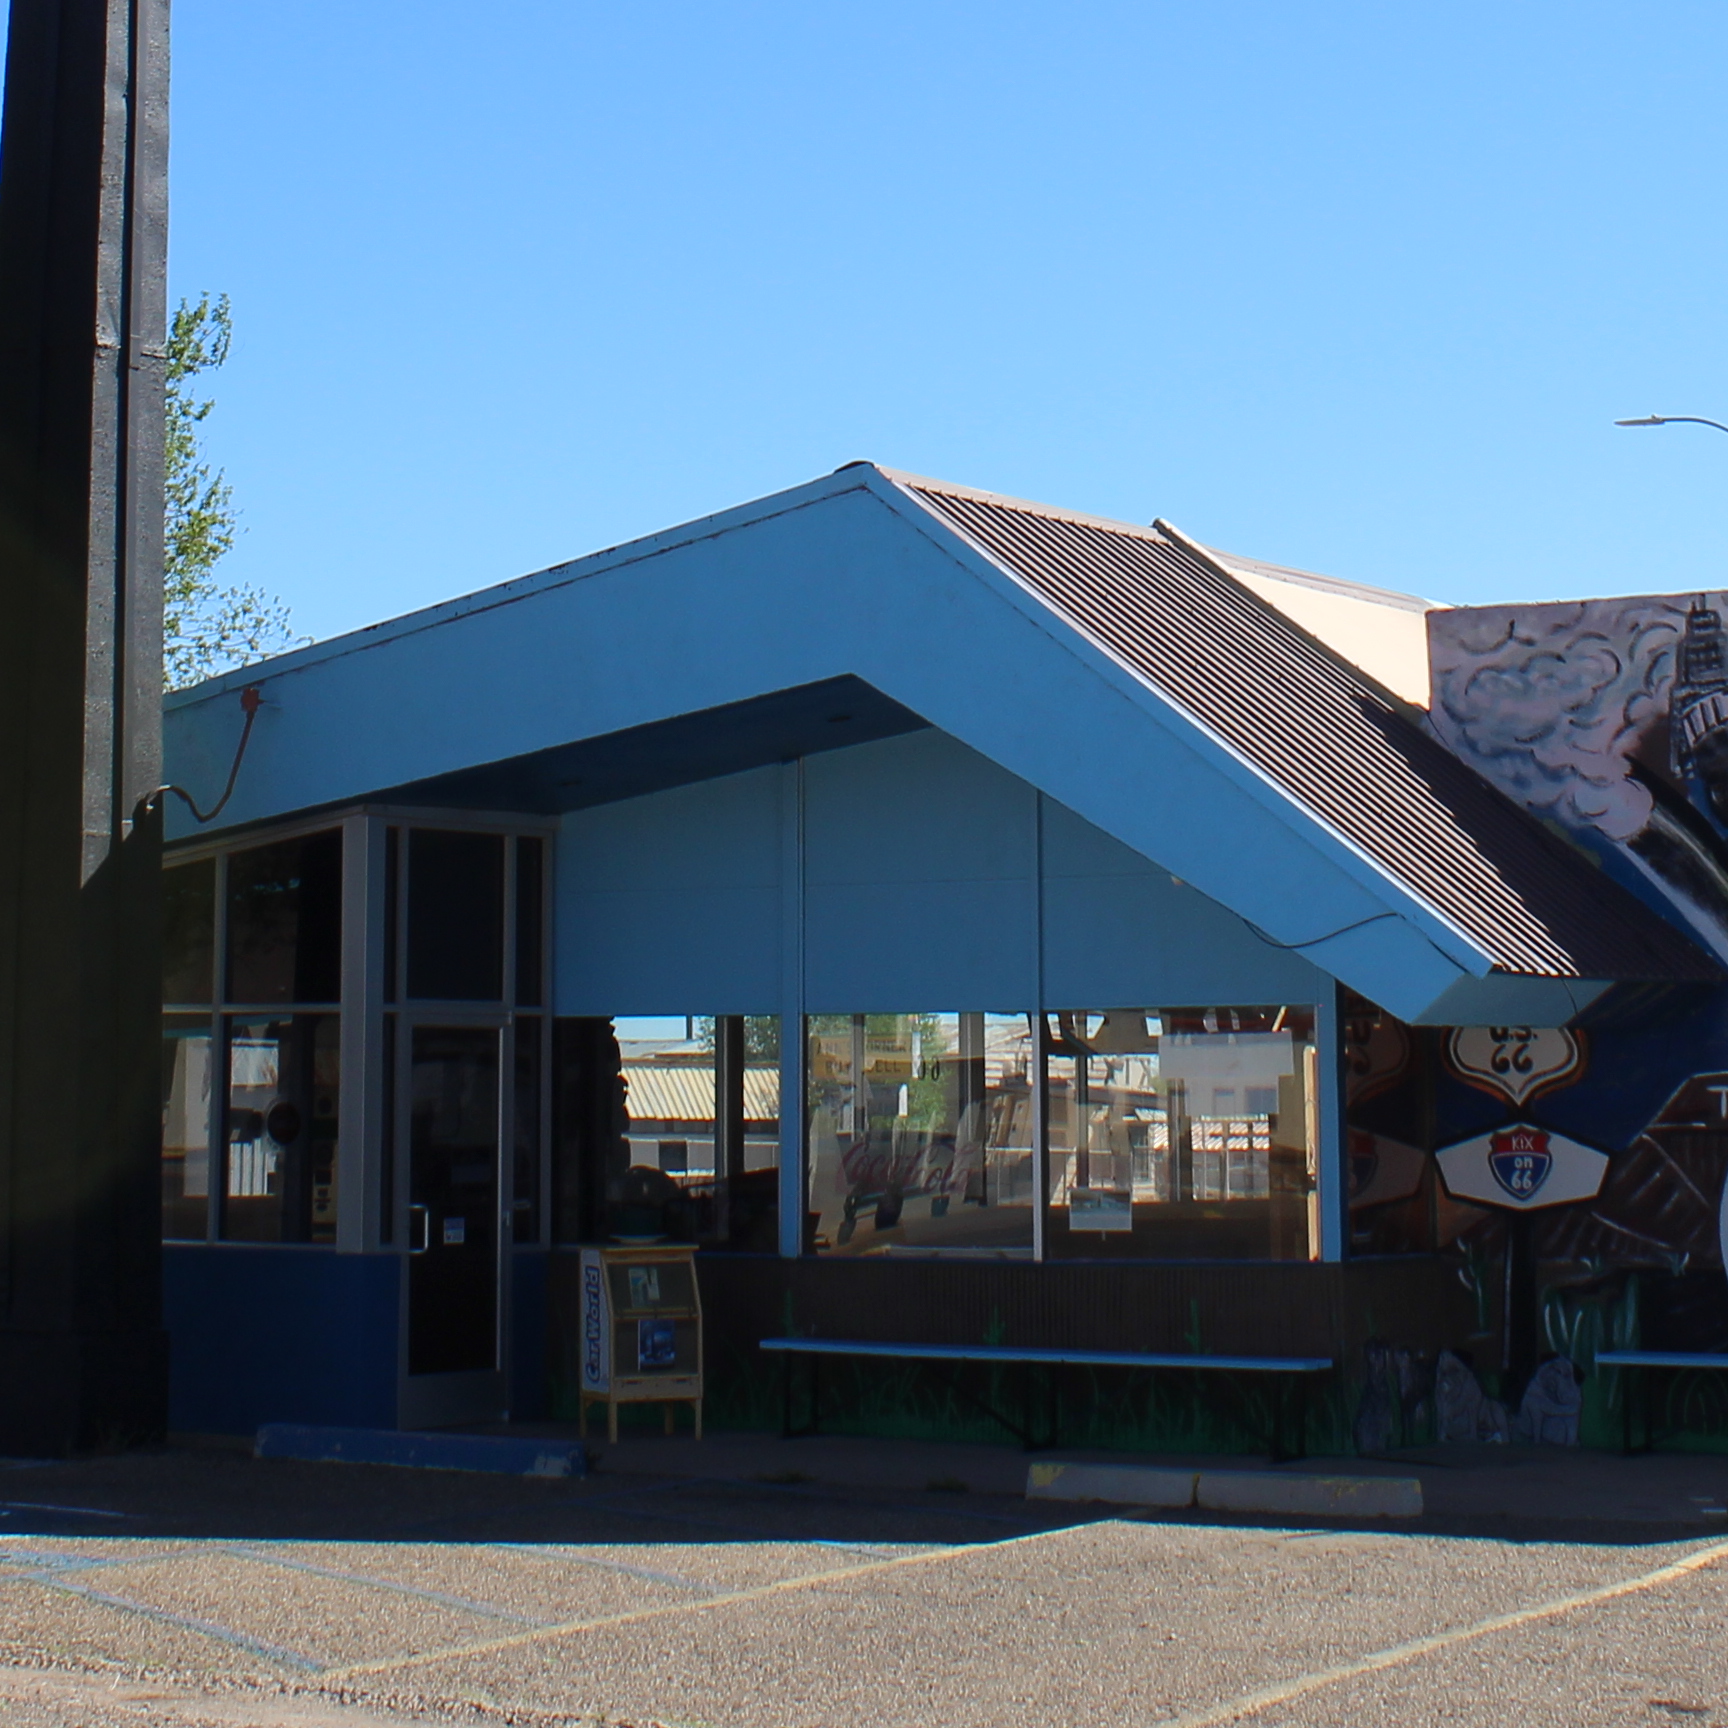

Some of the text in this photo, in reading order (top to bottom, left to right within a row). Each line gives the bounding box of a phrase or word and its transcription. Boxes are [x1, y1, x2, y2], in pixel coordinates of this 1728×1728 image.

[1491, 1044, 1533, 1073] 66
[1514, 1156, 1534, 1170] on
[1511, 1171, 1532, 1190] 66
